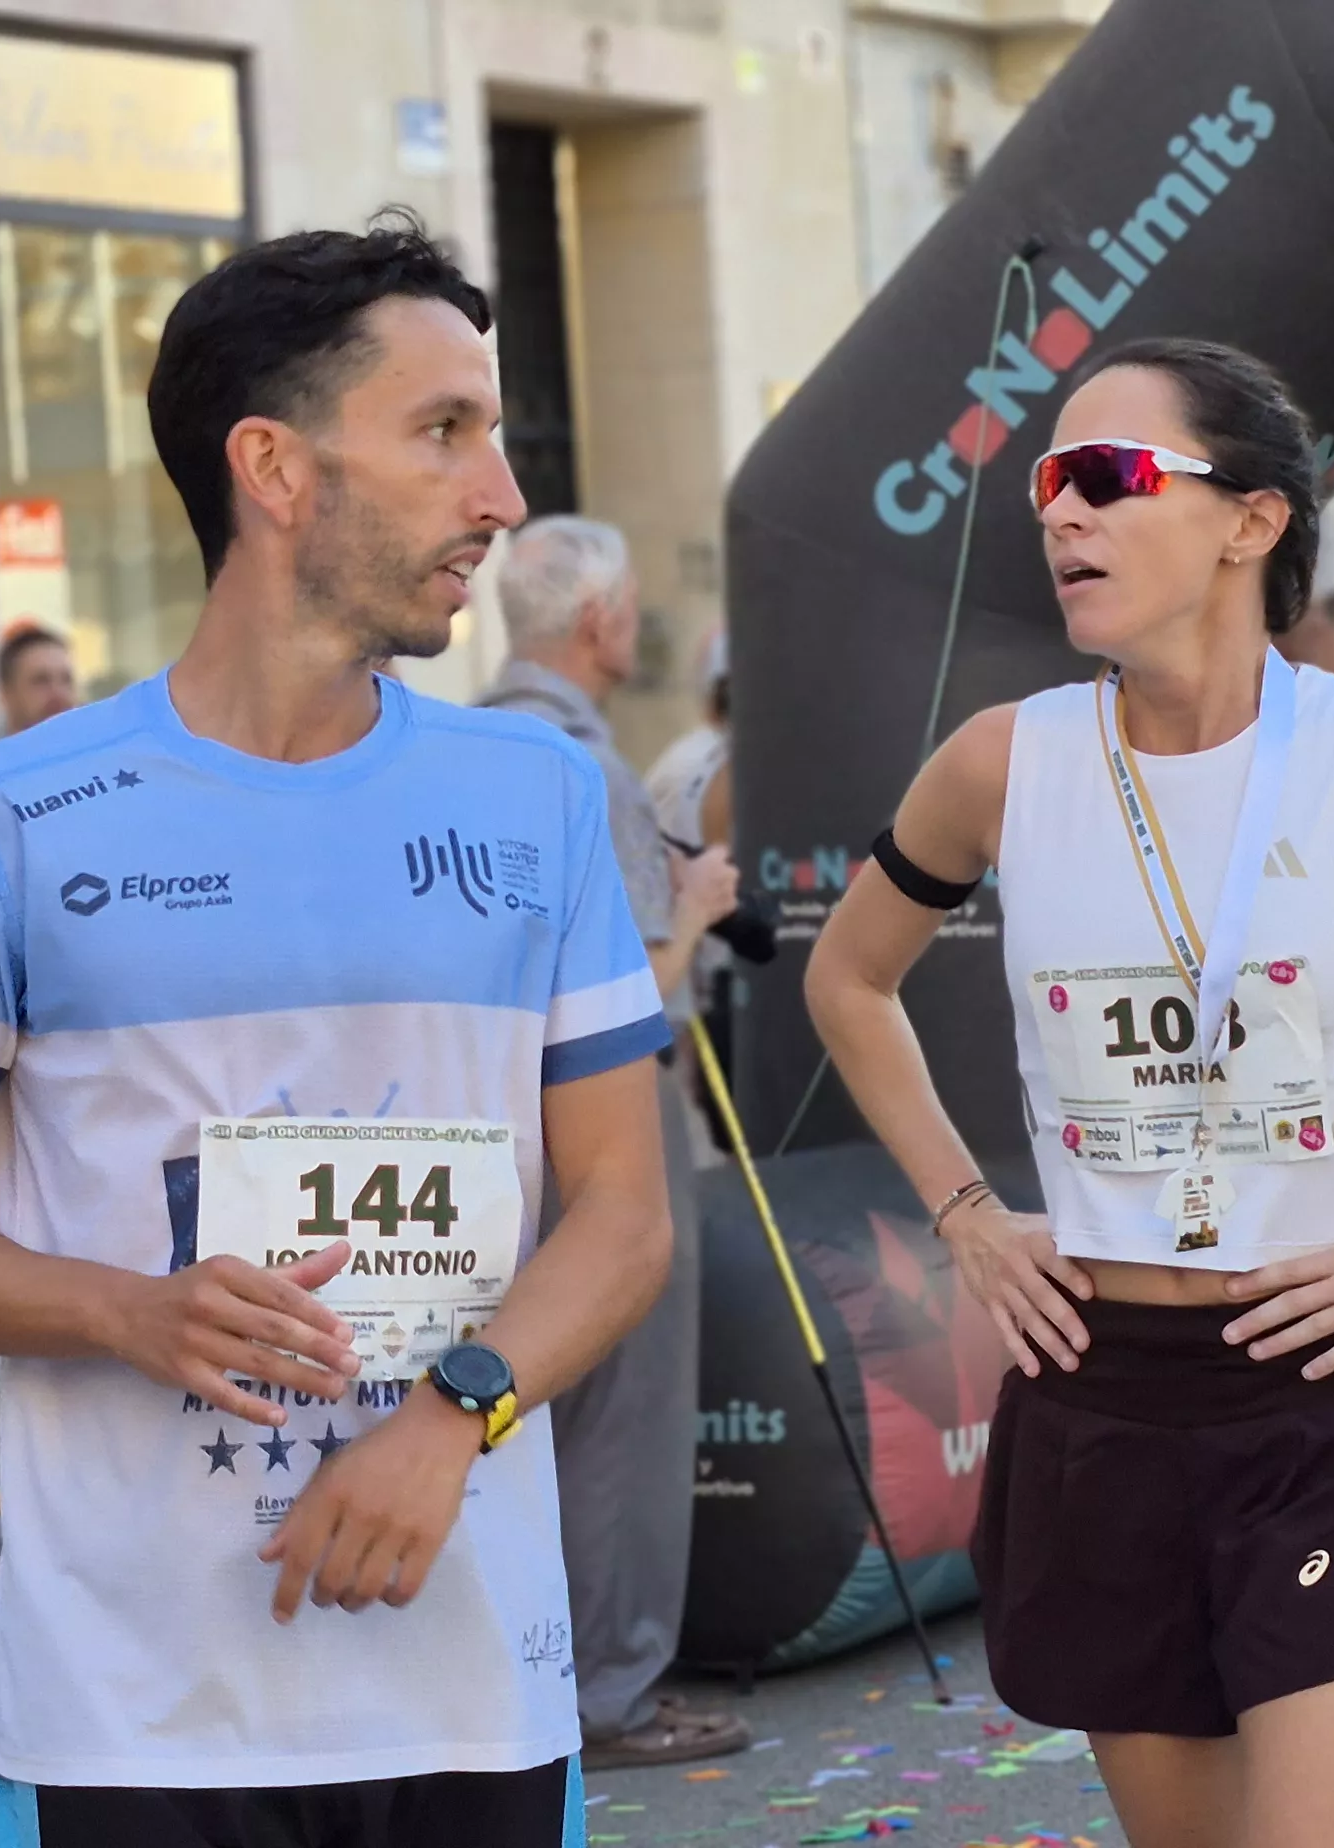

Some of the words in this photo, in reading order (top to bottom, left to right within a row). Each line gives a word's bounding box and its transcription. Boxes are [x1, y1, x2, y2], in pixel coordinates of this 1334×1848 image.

[12, 776, 108, 822] luanvi
[121, 873, 230, 902] Elproex
[300, 1125, 357, 1139] CIUDAD
[358, 1126, 381, 1140] DE
[382, 1126, 437, 1141] HUESCA
[298, 1163, 459, 1237] 144
[350, 1250, 476, 1275] ANTONIO
